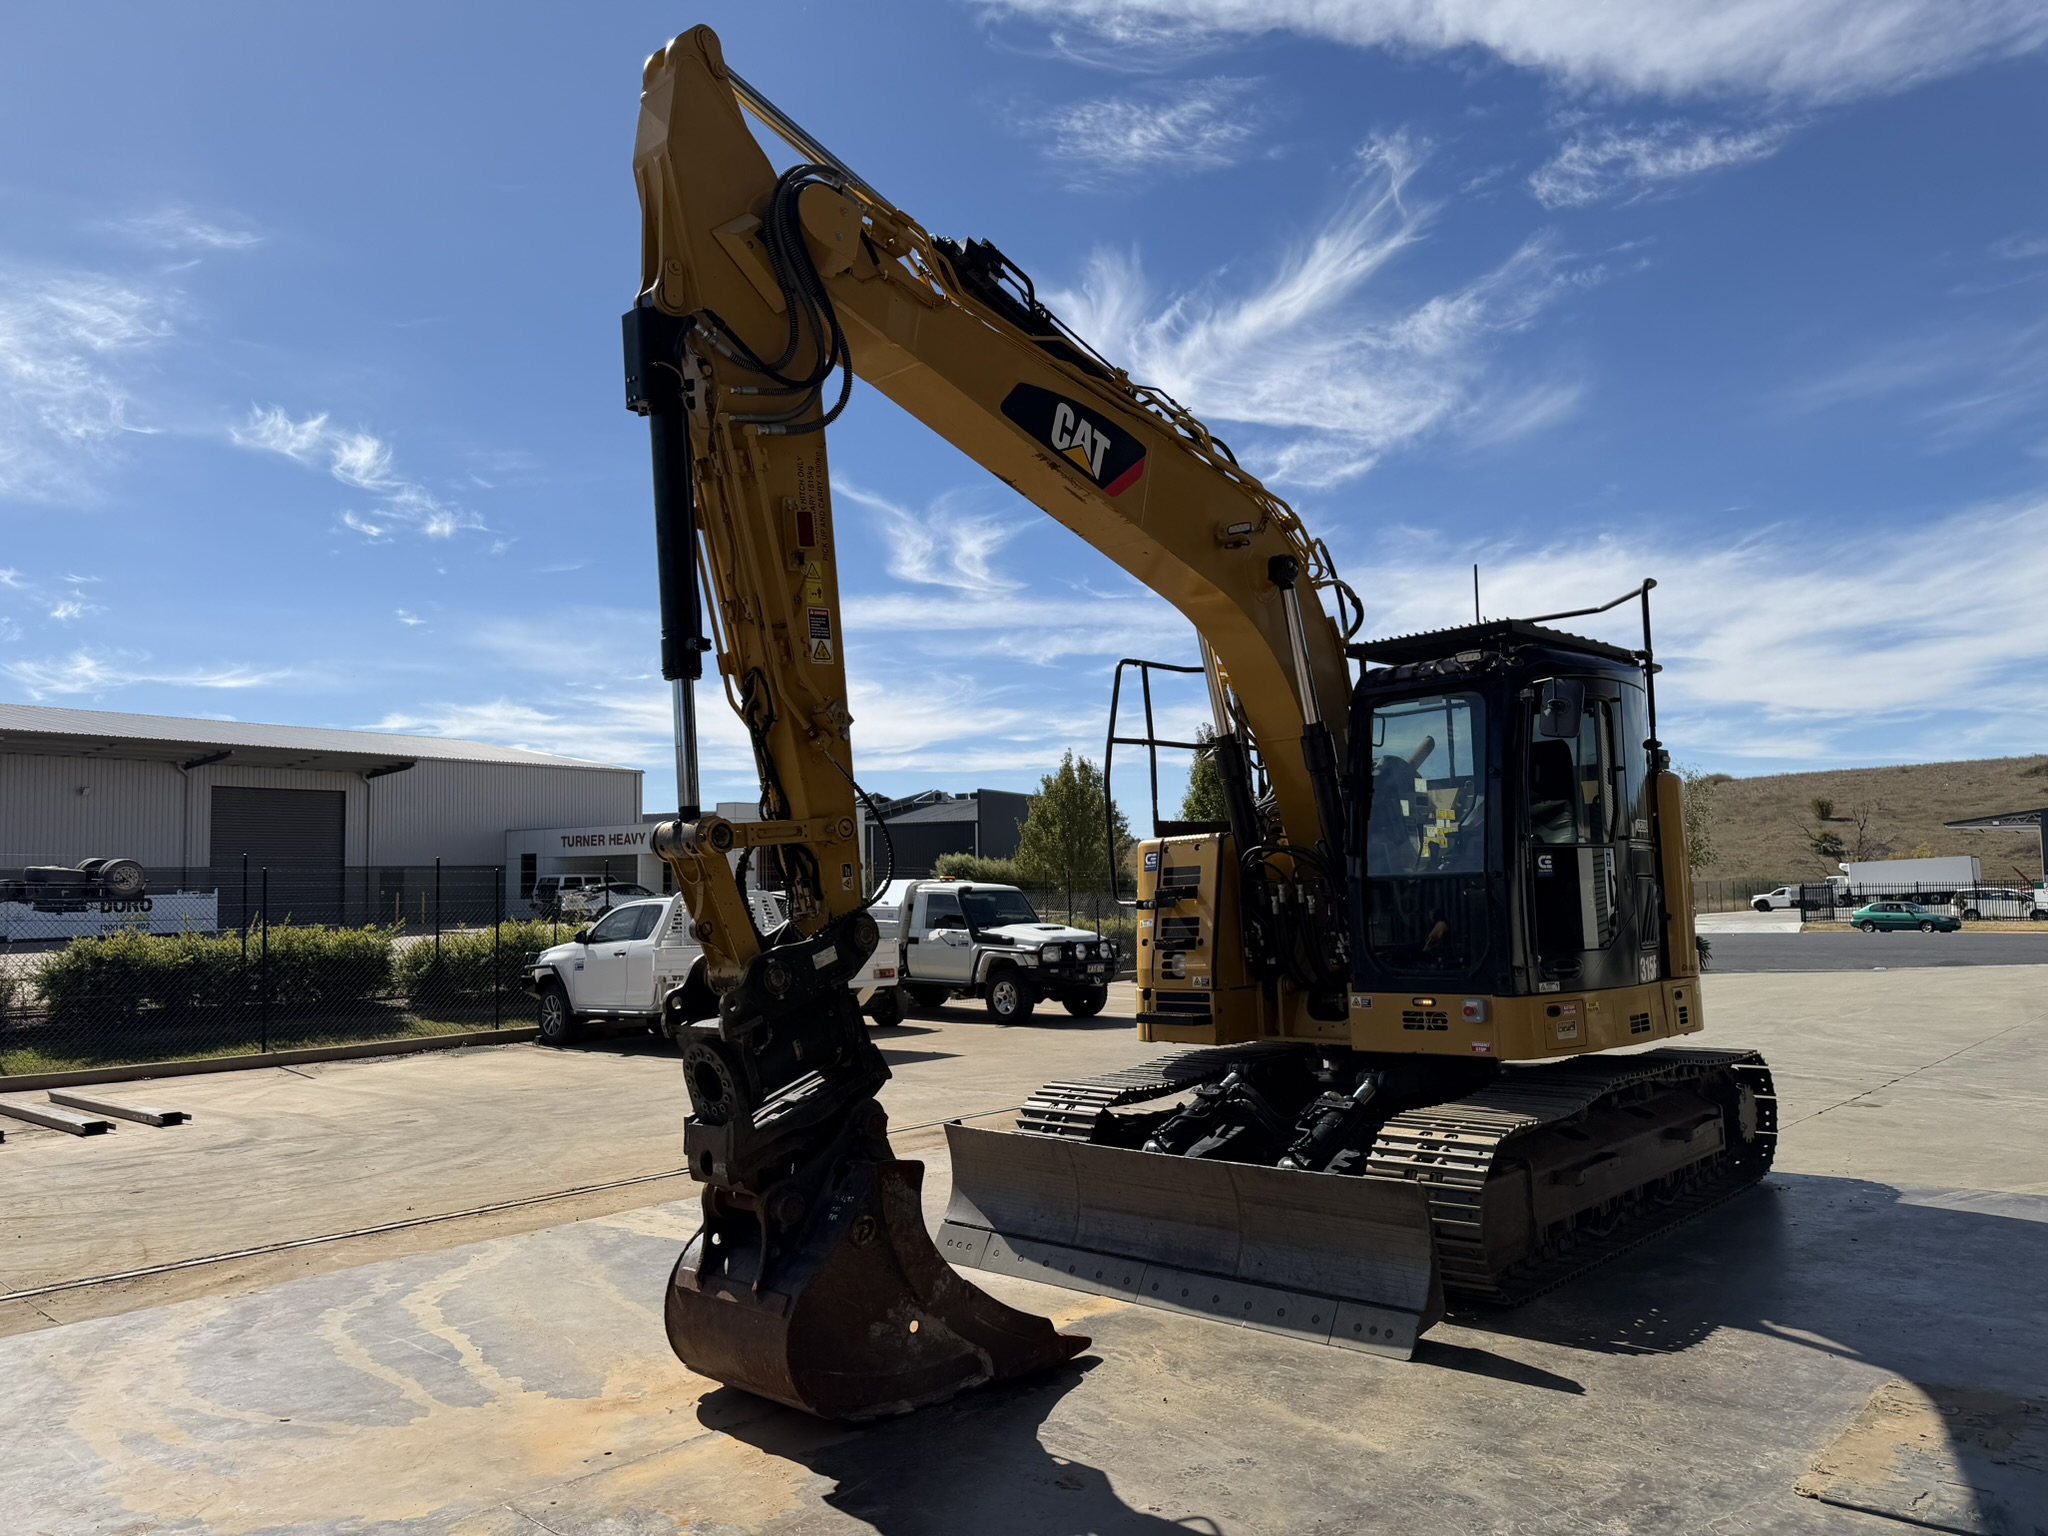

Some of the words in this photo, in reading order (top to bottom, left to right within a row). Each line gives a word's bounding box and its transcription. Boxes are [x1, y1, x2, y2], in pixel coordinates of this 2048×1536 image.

[1051, 402, 1111, 480] CAT
[796, 456, 804, 478] ONLY
[798, 480, 807, 504] HITCH
[816, 480, 825, 508] CARRY
[820, 529, 827, 541] UP
[821, 543, 829, 561] PICK
[560, 834, 605, 848] TURNER
[608, 832, 646, 846] HEAVY
[1640, 954, 1657, 982] 315F
